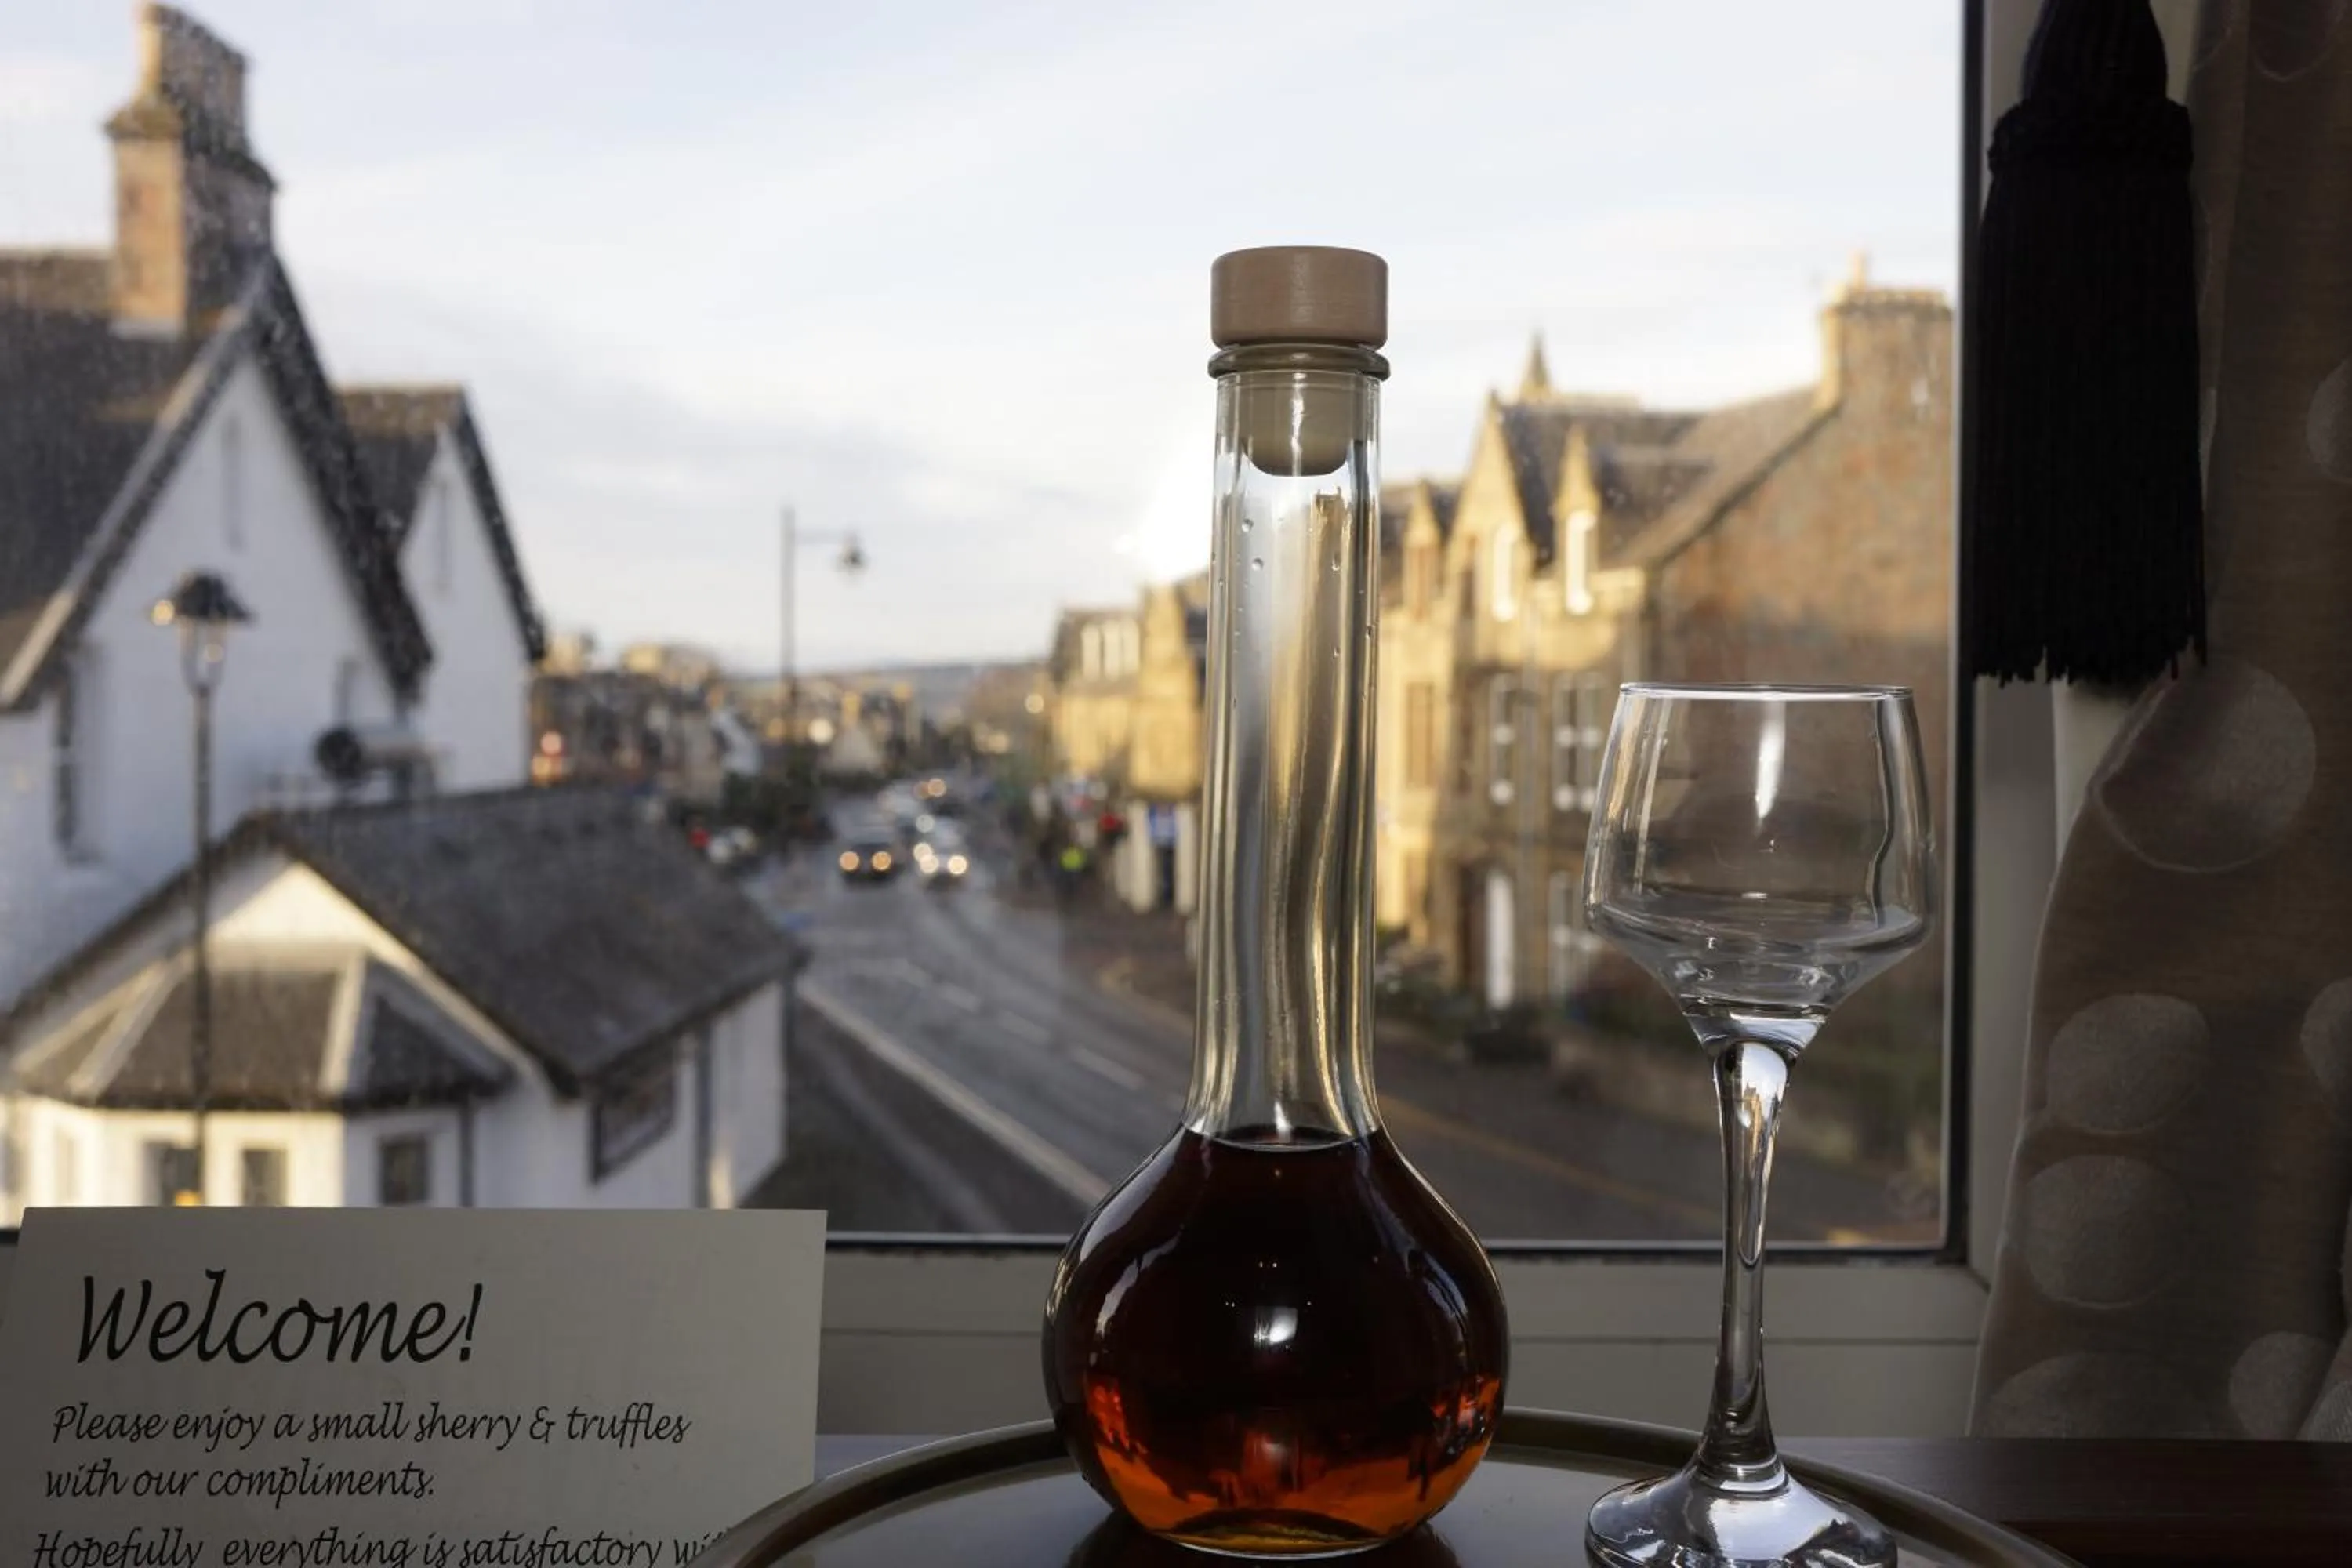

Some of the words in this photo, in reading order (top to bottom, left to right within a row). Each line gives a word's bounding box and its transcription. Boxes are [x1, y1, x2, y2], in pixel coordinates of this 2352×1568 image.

[76, 1269, 484, 1363] Welcome!
[52, 1402, 168, 1443] Please
[172, 1408, 266, 1453] enjoy
[274, 1414, 304, 1439] a
[307, 1401, 410, 1443] small
[413, 1401, 521, 1451] sherry
[528, 1406, 555, 1443] &
[566, 1406, 692, 1449] truffles
[45, 1457, 129, 1497] with
[132, 1469, 199, 1497] our
[206, 1457, 434, 1509] compliments.
[34, 1526, 204, 1568] Hopefully
[223, 1526, 418, 1568] everything
[423, 1532, 456, 1568] is
[458, 1526, 662, 1568] satisfactory
